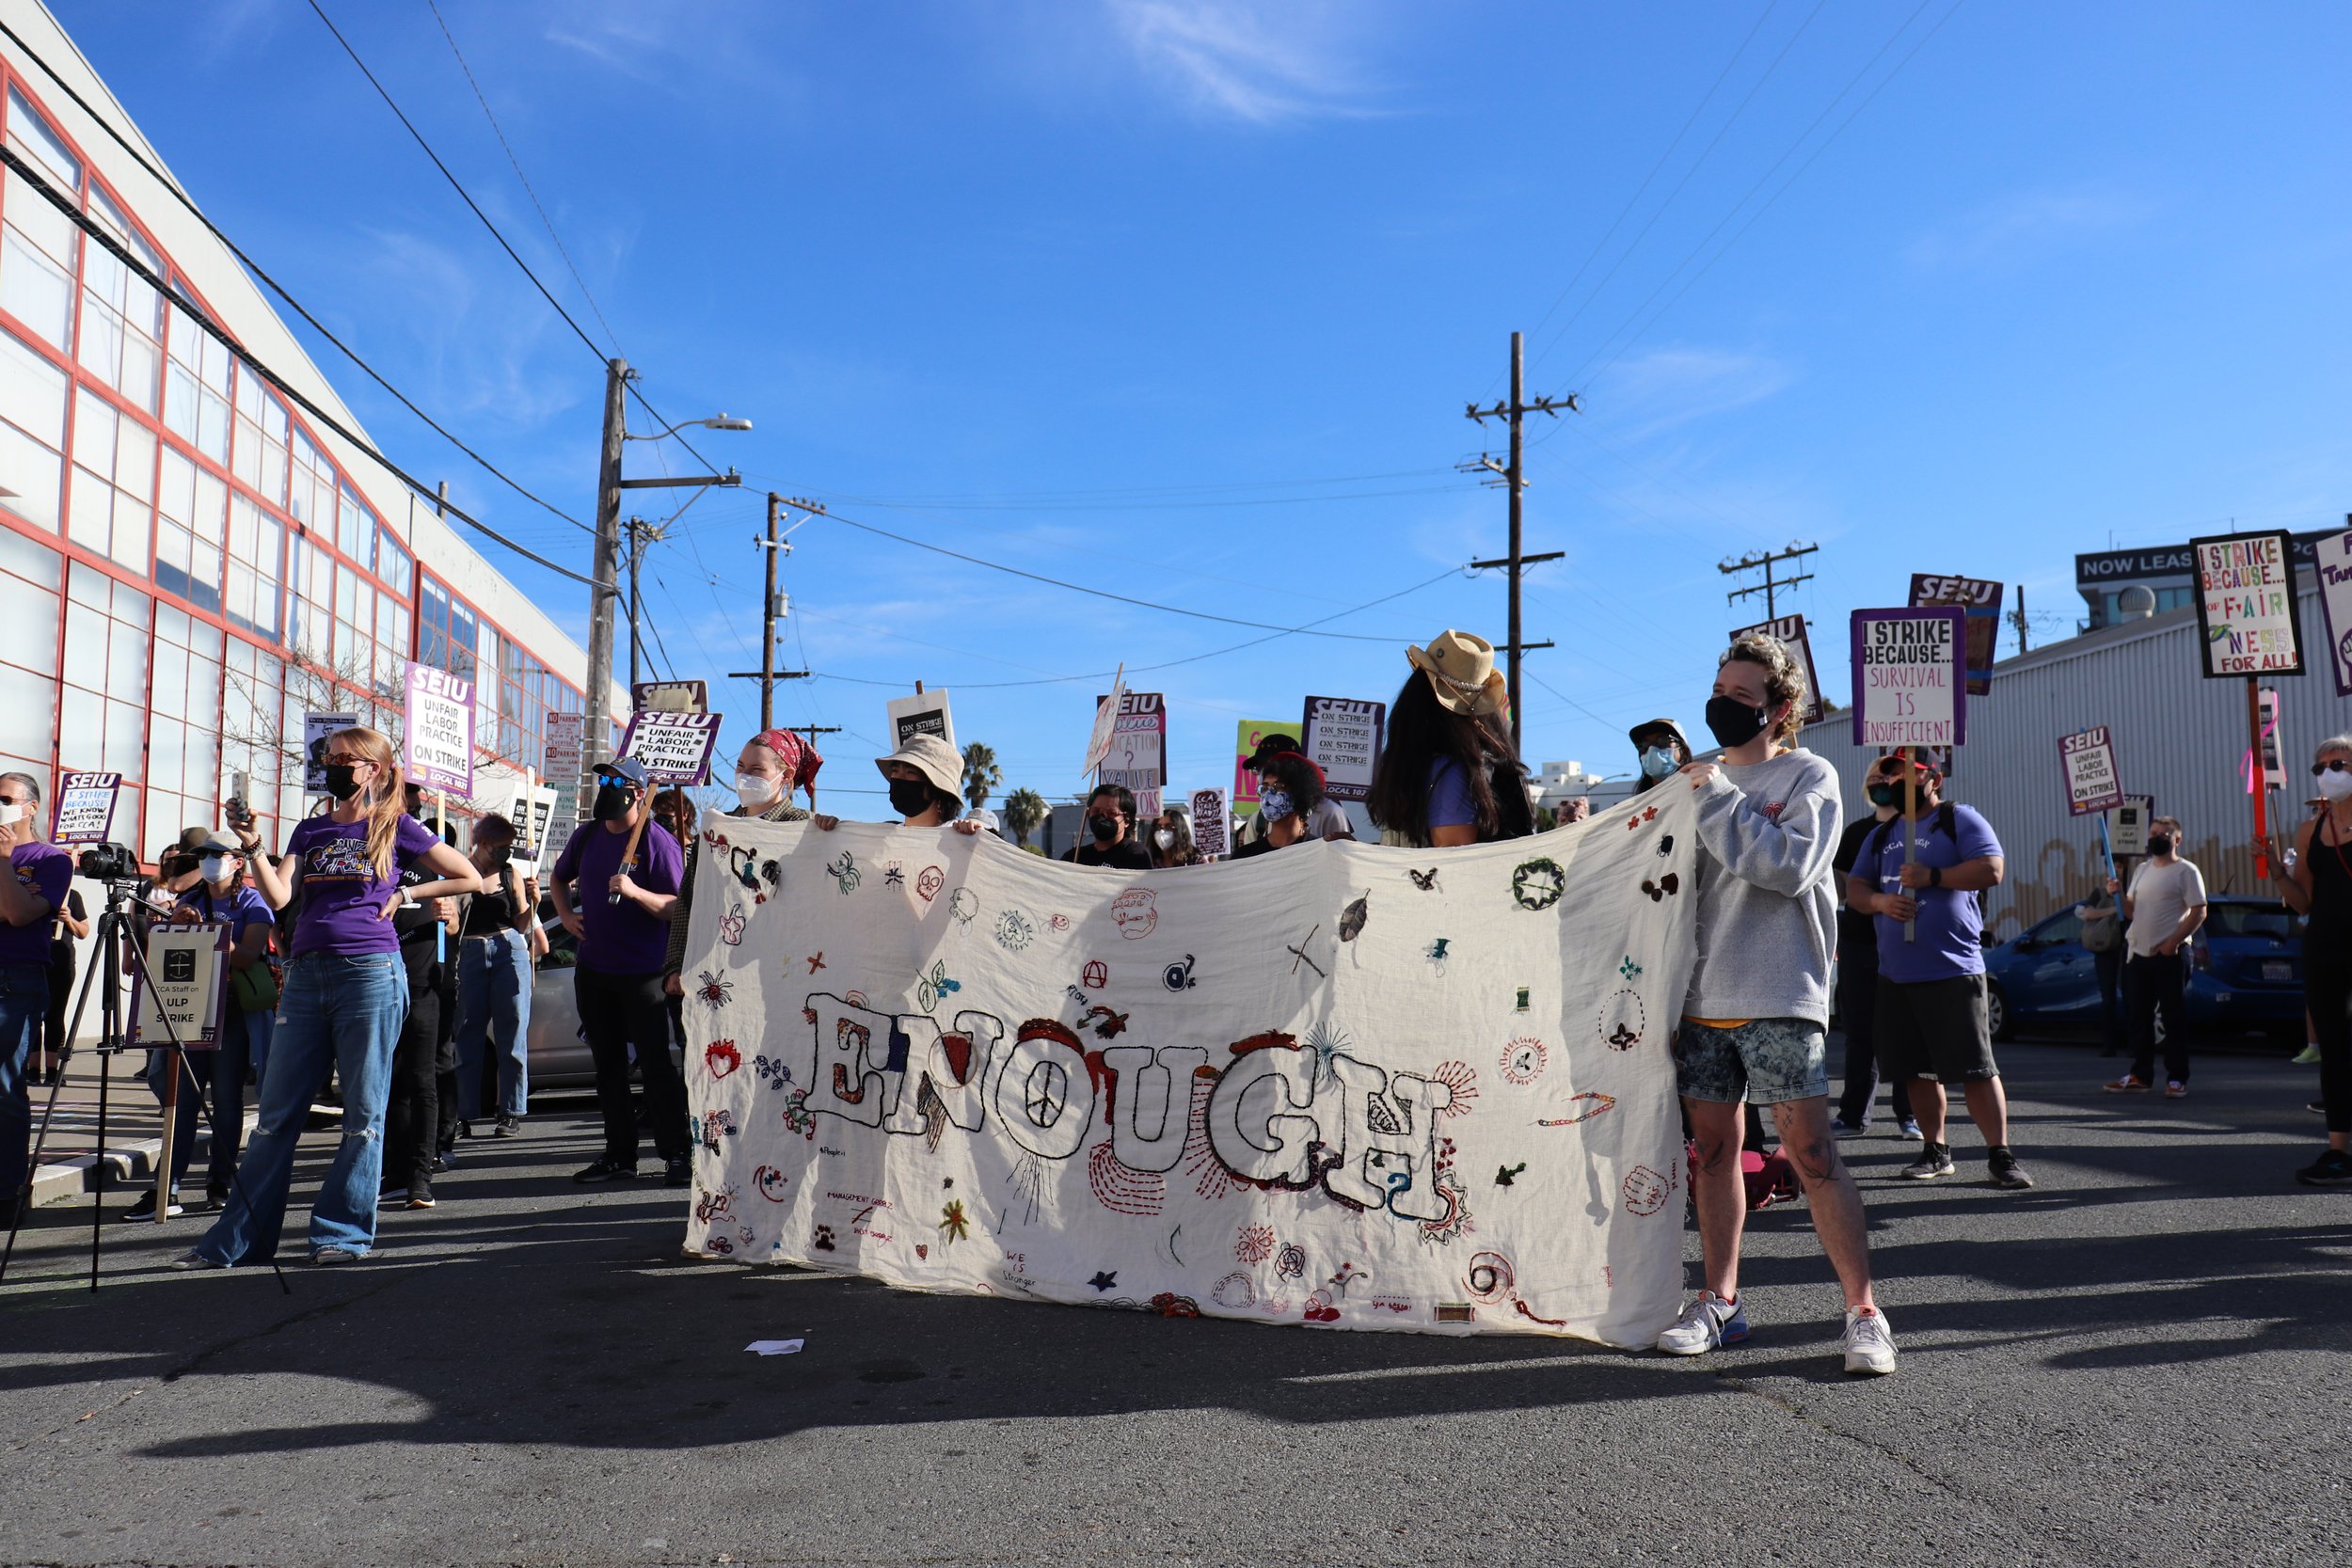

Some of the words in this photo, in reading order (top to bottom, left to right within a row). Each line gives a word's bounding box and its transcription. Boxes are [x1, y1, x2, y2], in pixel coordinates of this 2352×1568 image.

[2199, 547, 2206, 571] I
[2210, 538, 2279, 570] STRIKE
[2083, 557, 2134, 576] NOW
[2140, 552, 2193, 571] LEAS
[1918, 578, 1994, 604] SEIU
[1863, 622, 1868, 644] I
[1875, 620, 1950, 645] STRIKE
[2230, 628, 2290, 655] NESS
[2221, 656, 2255, 672] FOR
[2262, 652, 2297, 669] ALL!
[412, 666, 469, 703] SEIU
[1869, 667, 1947, 688] SURVIVAL
[424, 698, 459, 720] UNFAIR
[1119, 695, 1158, 714] EIU
[1895, 692, 1915, 716] IS
[425, 713, 458, 733] LABOR
[548, 713, 558, 722] NO
[639, 712, 714, 728] SEIU
[915, 717, 943, 730] STRIKE
[1115, 717, 1157, 732] alue
[1338, 714, 1371, 723] STRIKE
[420, 724, 463, 749] PRACTICE
[649, 728, 694, 739] UNFAIR
[1337, 727, 1369, 736] STRIKE
[1864, 721, 1951, 743] INSUFFICIENT
[647, 736, 691, 747] LABOR
[1336, 741, 1369, 751] STRIKE
[2064, 728, 2105, 753] SEIU
[547, 748, 556, 757] NO
[637, 744, 696, 756] PRACTICE
[2075, 750, 2103, 764] UNFAIR
[414, 744, 433, 761] ON
[435, 749, 468, 772] STRIKE
[651, 757, 699, 769] STRIKE
[1334, 755, 1367, 765] STRIKE
[2077, 759, 2104, 772] LABOR
[67, 773, 117, 788] SEIU
[429, 771, 453, 785] LOCAL
[453, 778, 468, 790] 1021
[647, 771, 673, 780] OCAL
[2075, 768, 2109, 783] PRACTICE
[2074, 788, 2089, 799] ON
[2090, 781, 2116, 796] STRIKE
[65, 800, 106, 809] BECAUSE
[558, 796, 576, 804] KING
[167, 998, 188, 1006] ULP
[801, 991, 1455, 1224] ENOUGH
[827, 1192, 869, 1204] MANAGEMENT
[1007, 1250, 1025, 1261] WE
[1013, 1263, 1025, 1273] IS
[1003, 1270, 1036, 1288] Stronger
